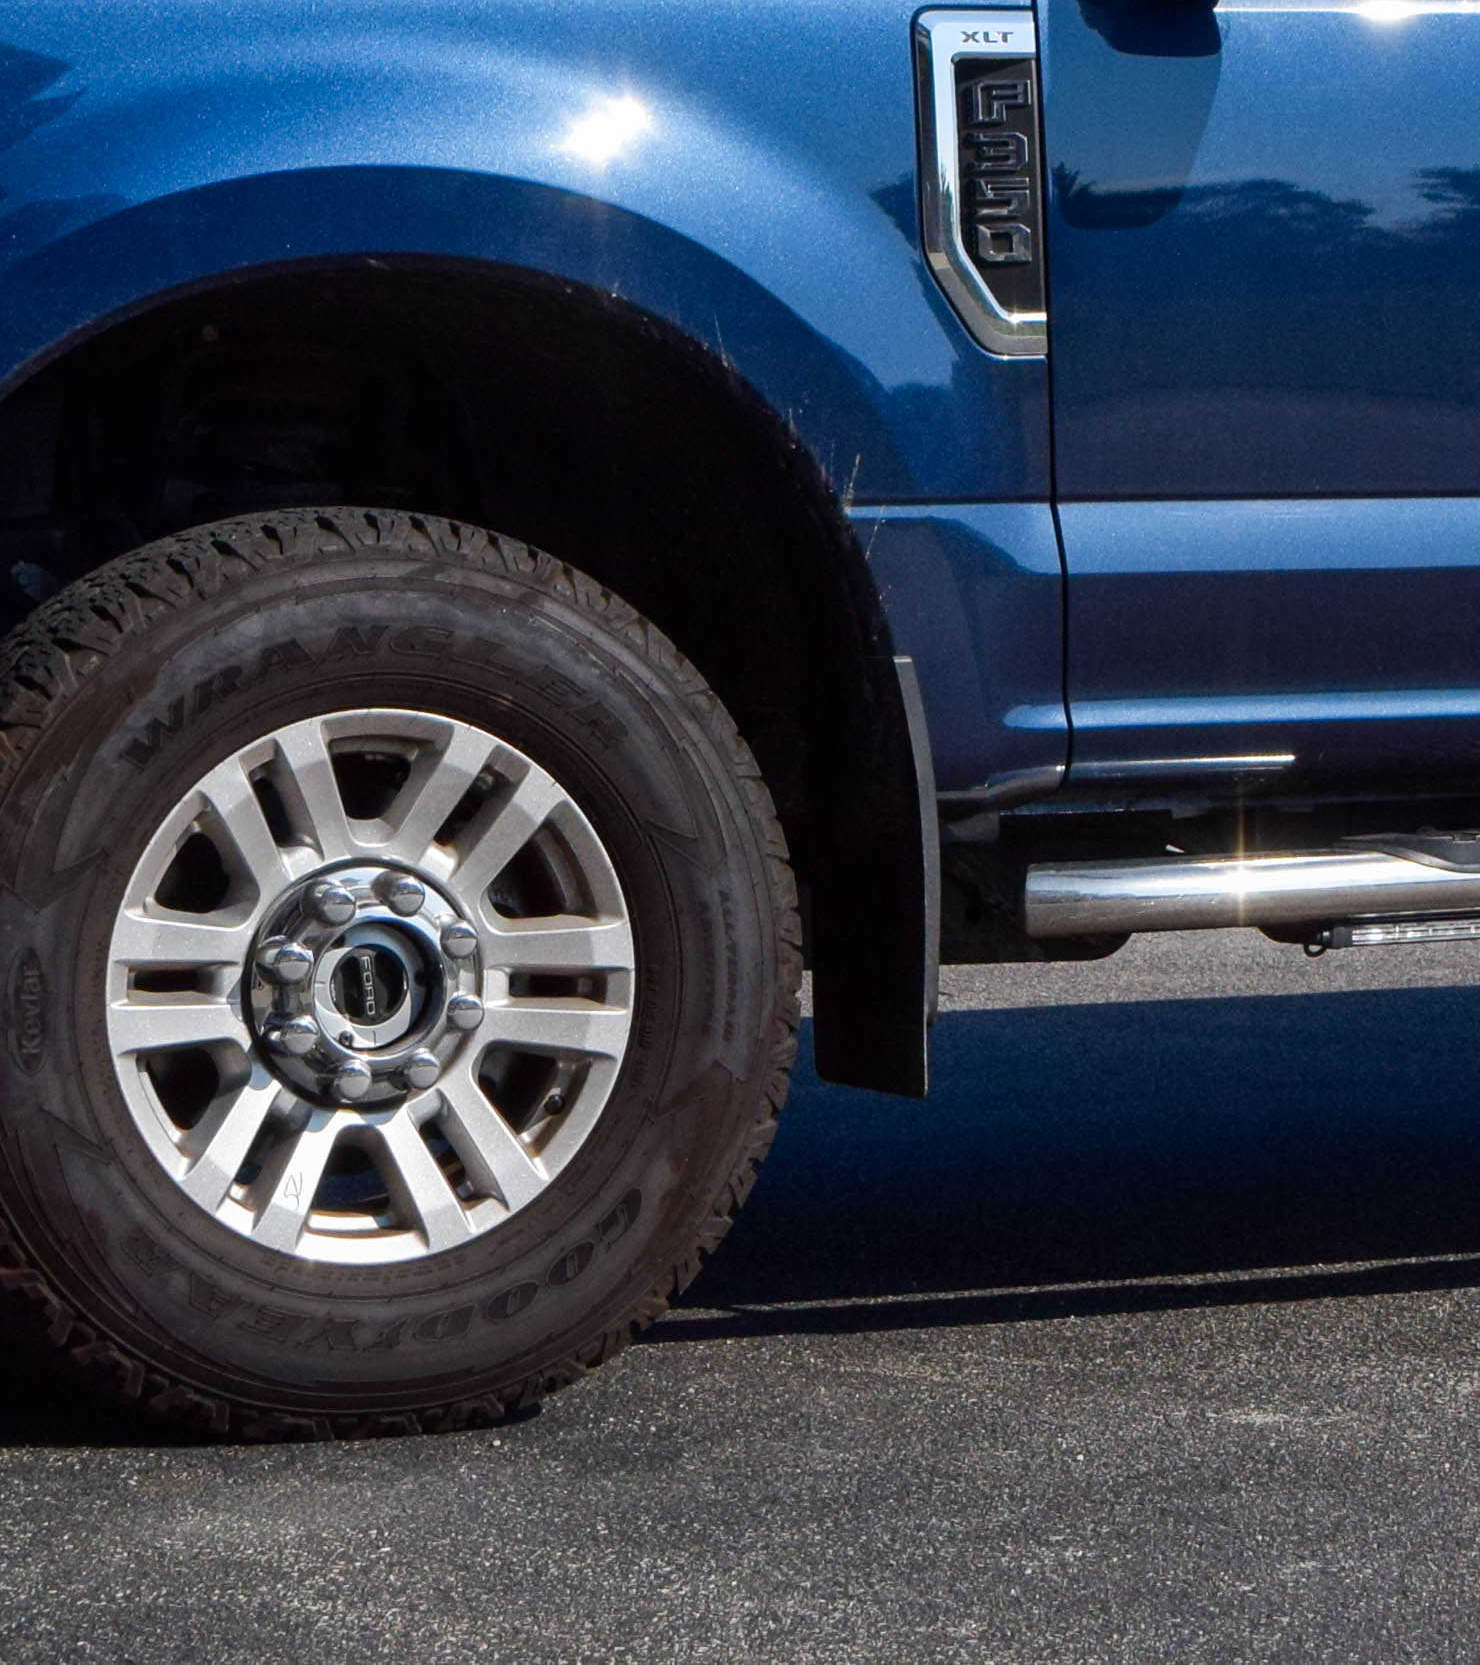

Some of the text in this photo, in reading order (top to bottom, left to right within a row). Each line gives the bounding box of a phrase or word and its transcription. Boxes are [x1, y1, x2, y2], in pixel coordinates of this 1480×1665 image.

[960, 30, 1014, 44] XLT
[120, 624, 628, 770] WRANGLER
[20, 963, 42, 1054] Kevlar
[361, 955, 376, 1015] FORD
[120, 1187, 643, 1351] GOODYEAR
